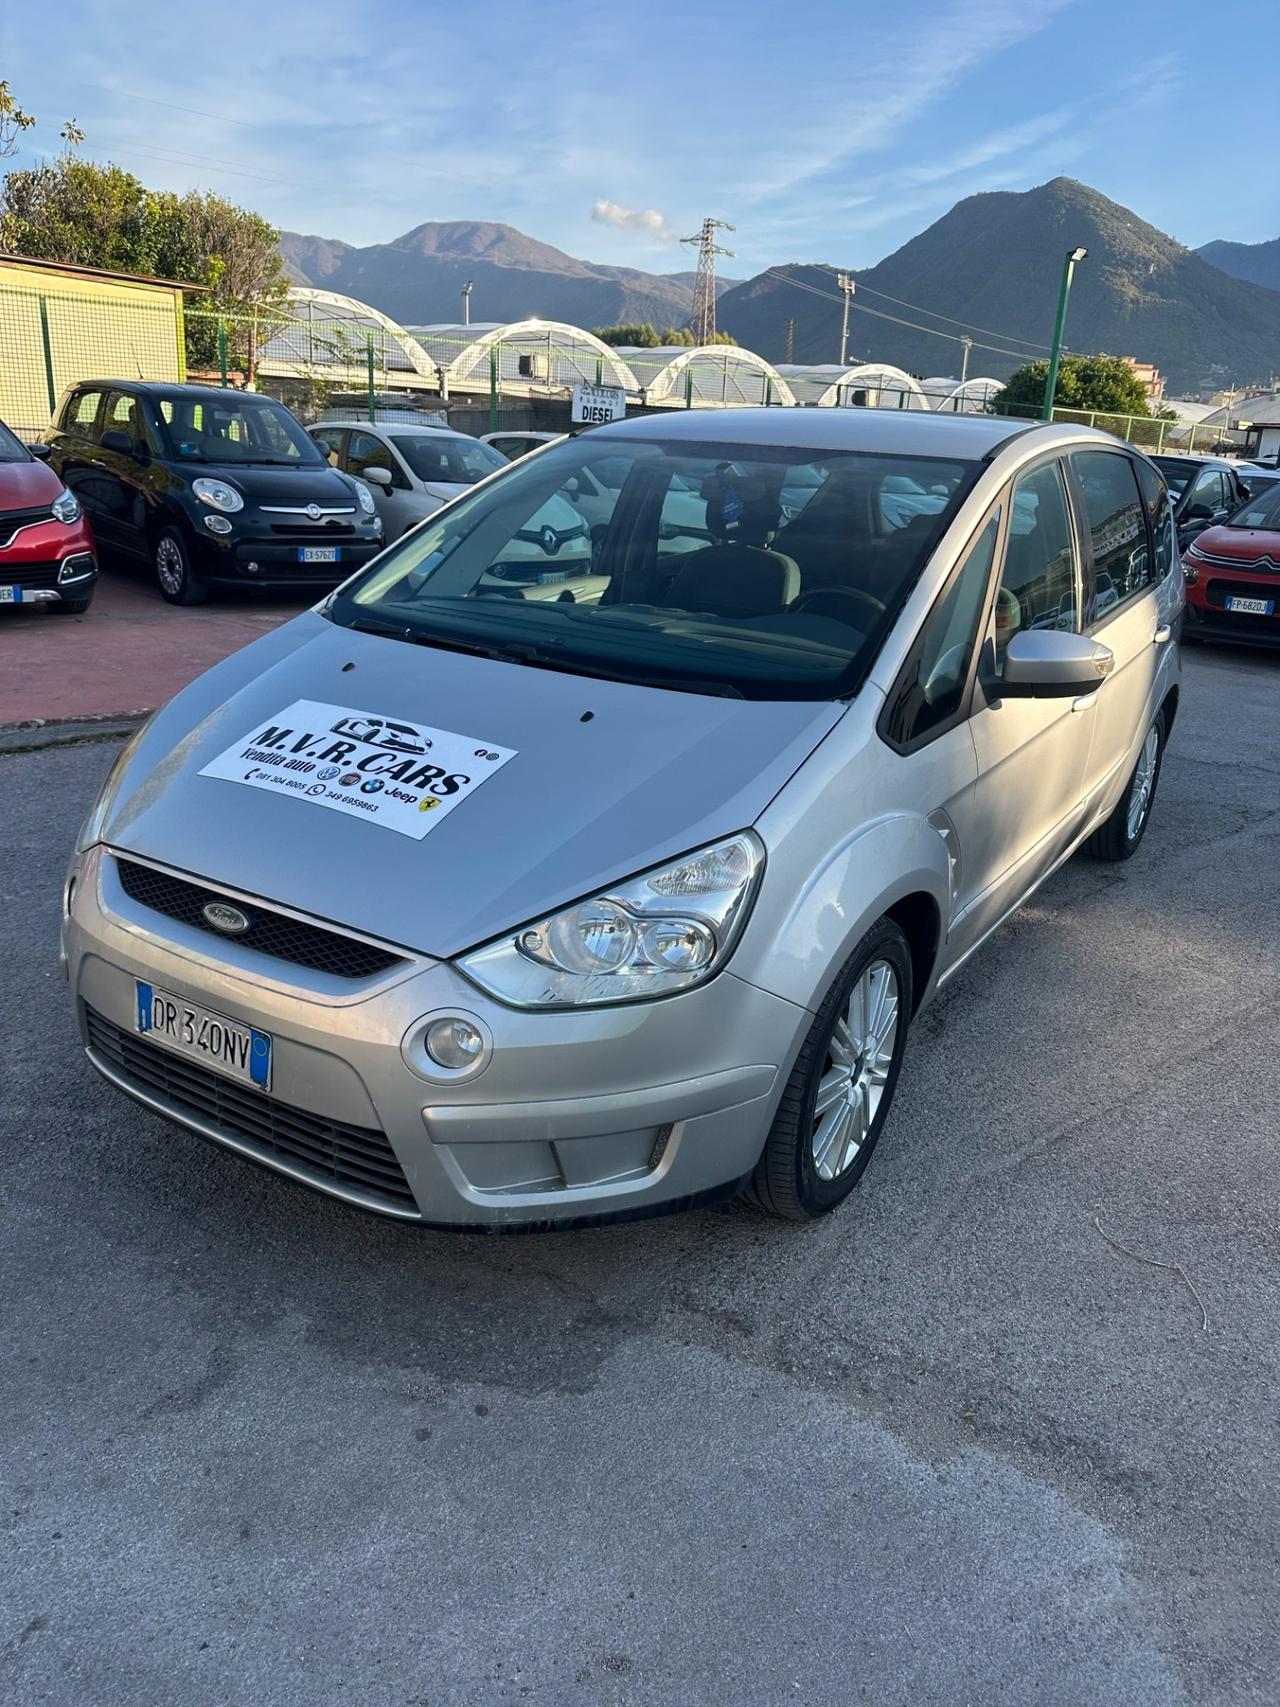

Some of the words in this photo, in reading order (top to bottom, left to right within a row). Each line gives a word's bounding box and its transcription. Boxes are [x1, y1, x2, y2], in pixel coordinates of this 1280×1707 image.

[240, 747, 287, 766] Vendita
[283, 758, 317, 774] auto
[325, 790, 341, 801] 349
[384, 787, 418, 804] Jeep
[211, 906, 239, 926] Ford
[153, 995, 176, 1037] DR
